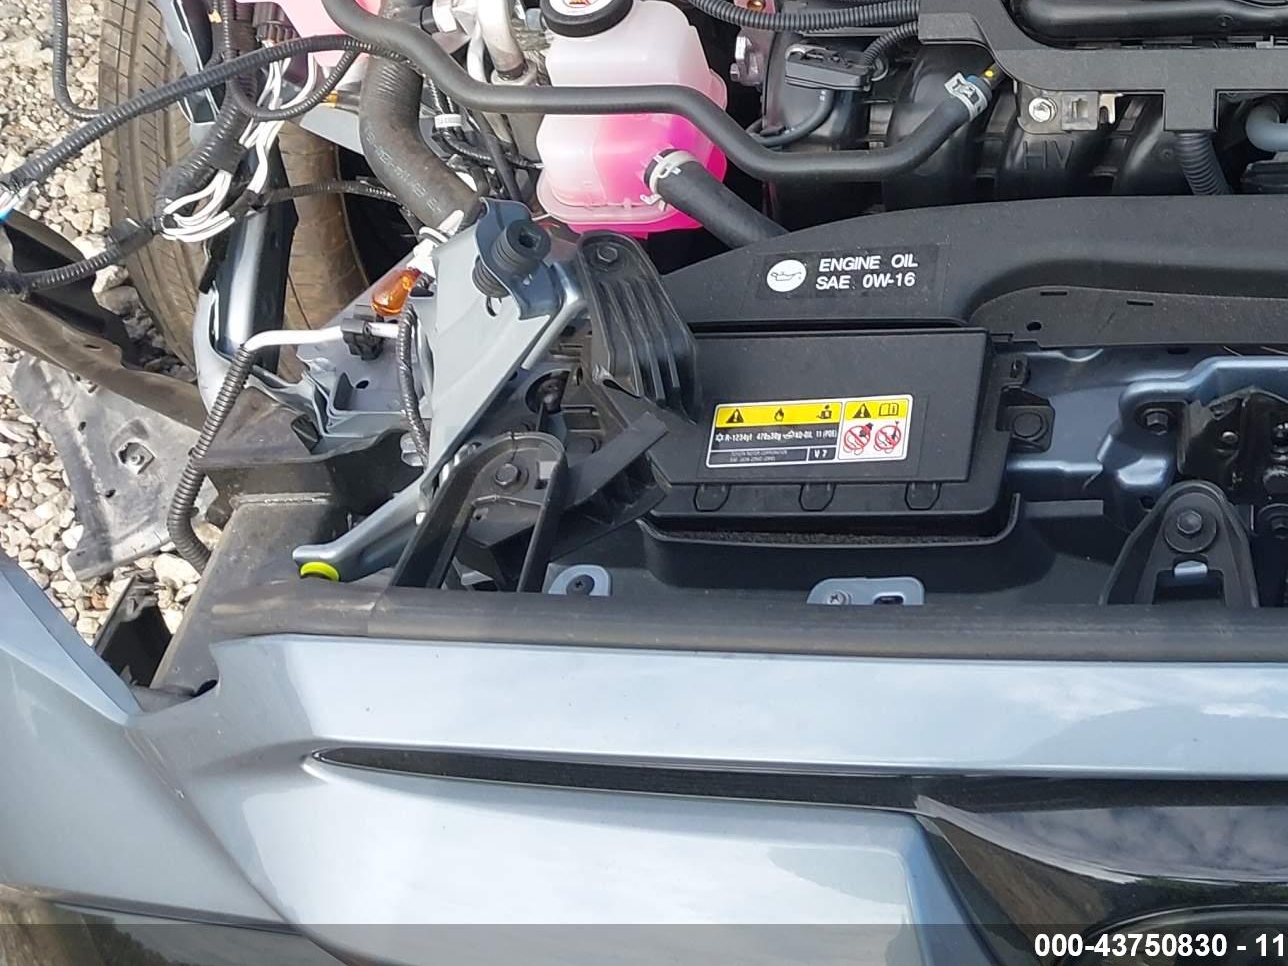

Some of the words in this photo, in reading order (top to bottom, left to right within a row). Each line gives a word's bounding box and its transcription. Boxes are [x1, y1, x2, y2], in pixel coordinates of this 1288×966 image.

[1022, 140, 1075, 170] HV
[818, 255, 881, 272] ENGINE
[891, 254, 919, 269] OIL
[815, 274, 851, 291] SAE
[862, 272, 916, 289] 0W-16
